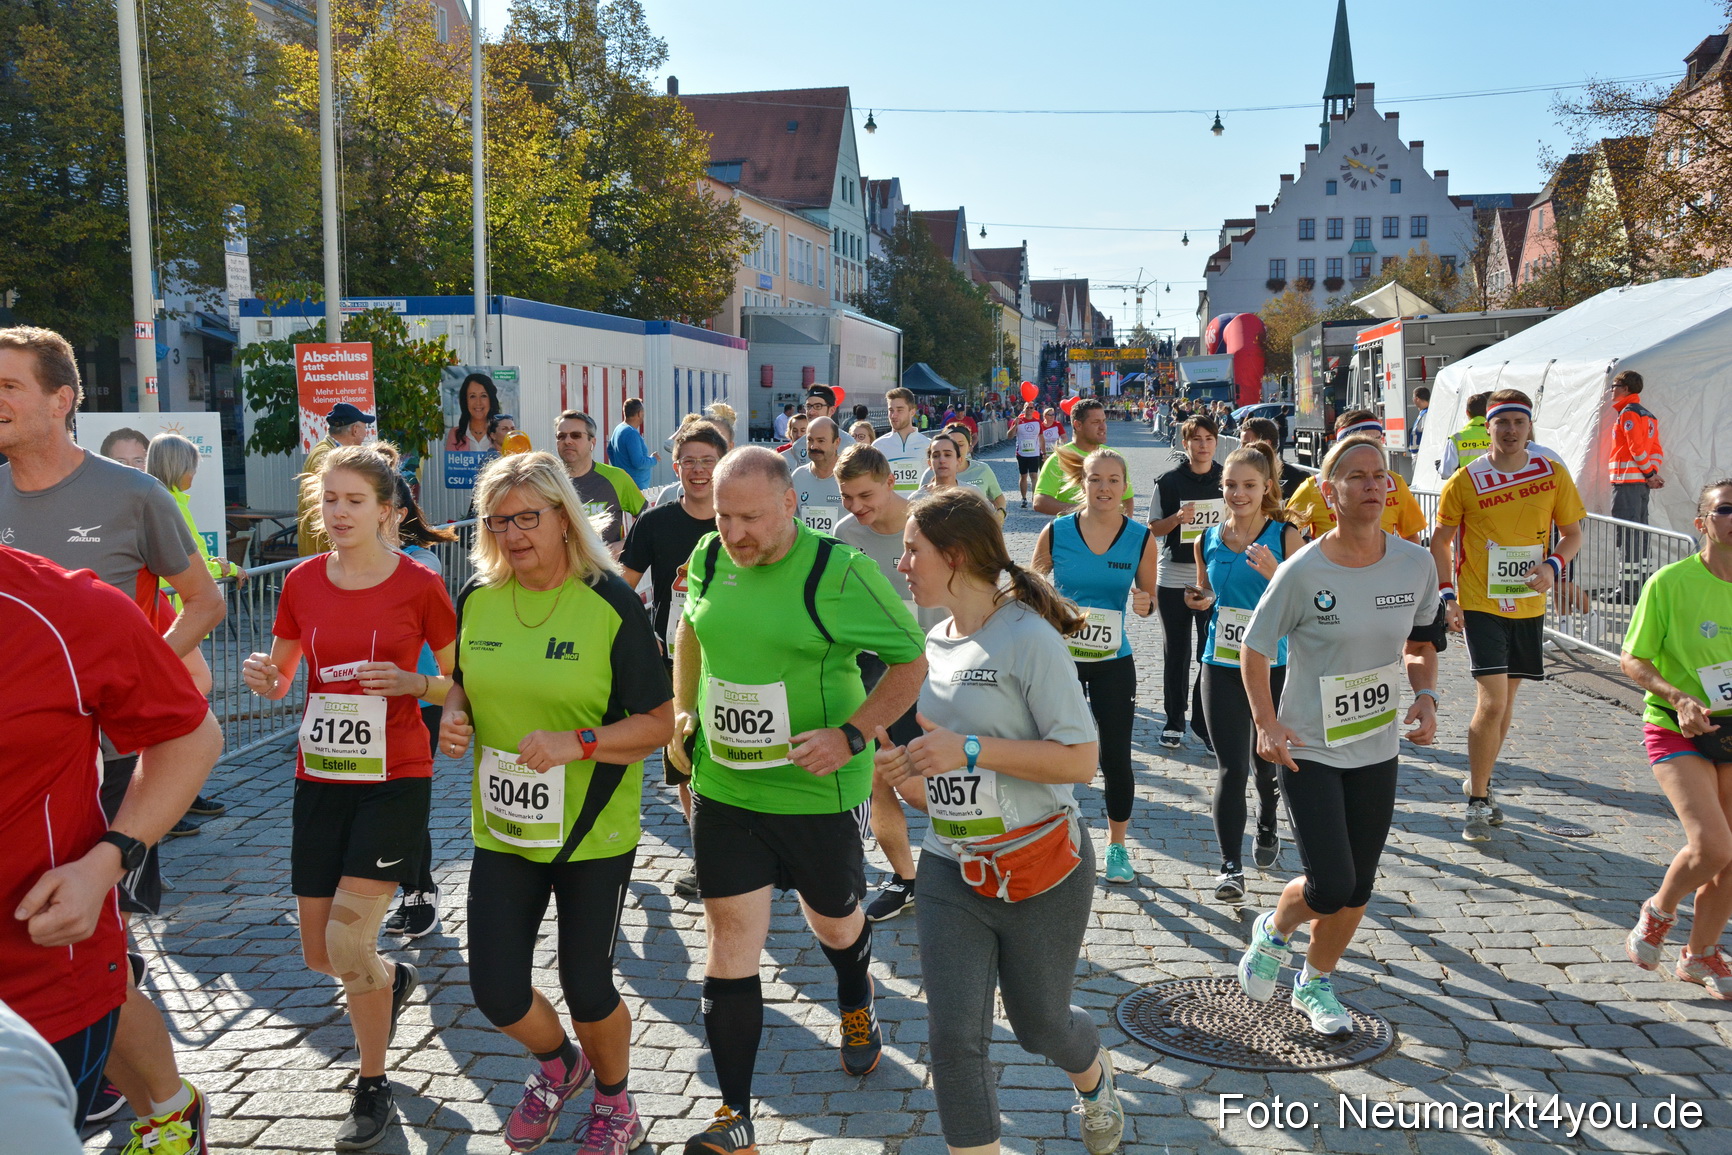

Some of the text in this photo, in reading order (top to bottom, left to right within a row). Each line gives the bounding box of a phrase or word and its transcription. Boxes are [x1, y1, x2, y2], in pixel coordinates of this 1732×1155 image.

[172, 348, 180, 364] 3
[303, 350, 368, 363] Abschluss
[1094, 350, 1121, 358] START
[303, 363, 325, 371] statt
[304, 371, 369, 382] Ausschluss!
[315, 386, 367, 396] Mehr Lehrer für
[313, 395, 368, 404] kleinere Klassen.
[448, 453, 475, 466] Helga
[448, 476, 465, 485] CSU
[893, 469, 918, 480] 5192
[1478, 480, 1556, 510] MAX BÖGL
[806, 517, 832, 530] 5129
[1107, 561, 1132, 570] THULE
[1375, 592, 1415, 607] BOCK
[1074, 648, 1103, 659] Hannah
[951, 668, 998, 683] BOCK
[1345, 673, 1379, 689] BOCK
[724, 689, 760, 702] BOCK
[1335, 683, 1390, 717] 5199
[324, 701, 359, 713] BOCK
[713, 704, 776, 735] 5062
[1341, 709, 1380, 723] PARTL Neumarkt
[310, 718, 372, 745] 5126
[720, 735, 735, 743] PARTL
[727, 748, 764, 760] Hubert
[322, 758, 357, 771] Estelle
[489, 774, 550, 810] 5046
[926, 775, 982, 806] 5057
[508, 811, 534, 820] Neumarkt
[506, 822, 522, 836] Ute
[949, 823, 968, 836] Ute
